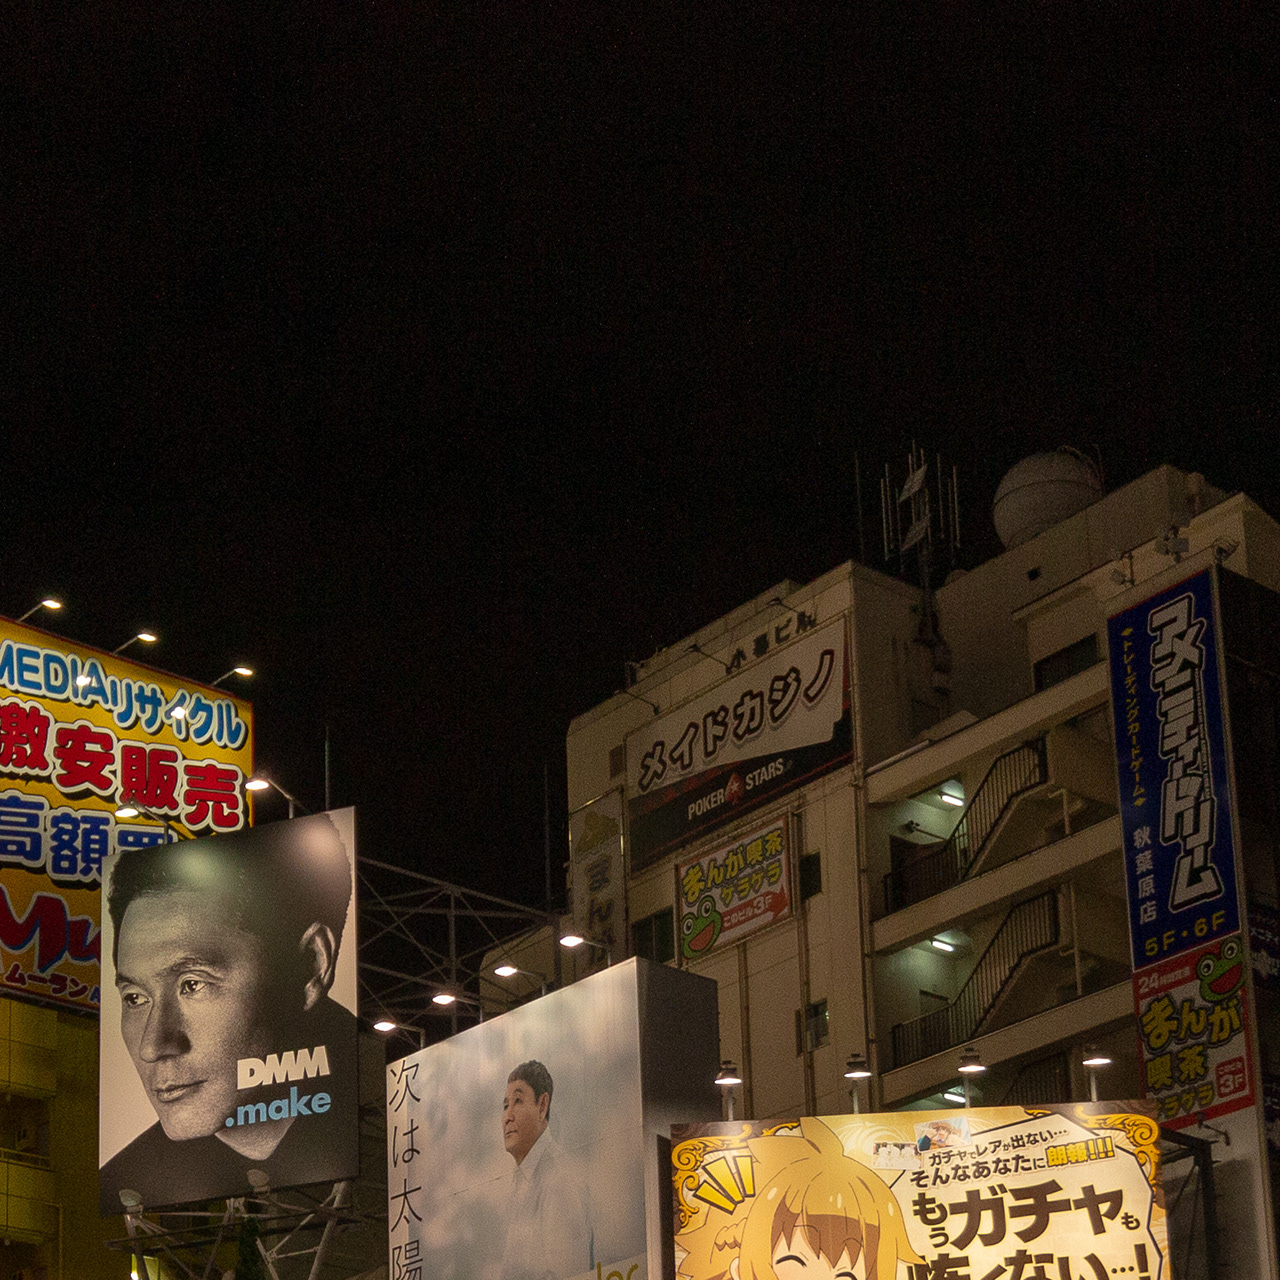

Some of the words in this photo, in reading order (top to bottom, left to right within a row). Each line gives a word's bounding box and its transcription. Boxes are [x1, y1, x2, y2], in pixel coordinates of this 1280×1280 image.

[638, 648, 835, 792] メイドカジノ
[687, 790, 725, 820] POKER
[745, 758, 785, 791] STARS
[1132, 825, 1158, 926] 秋葉原店
[1140, 993, 1244, 1054] まんが
[236, 1044, 331, 1091] DMM
[224, 1086, 332, 1128] .make
